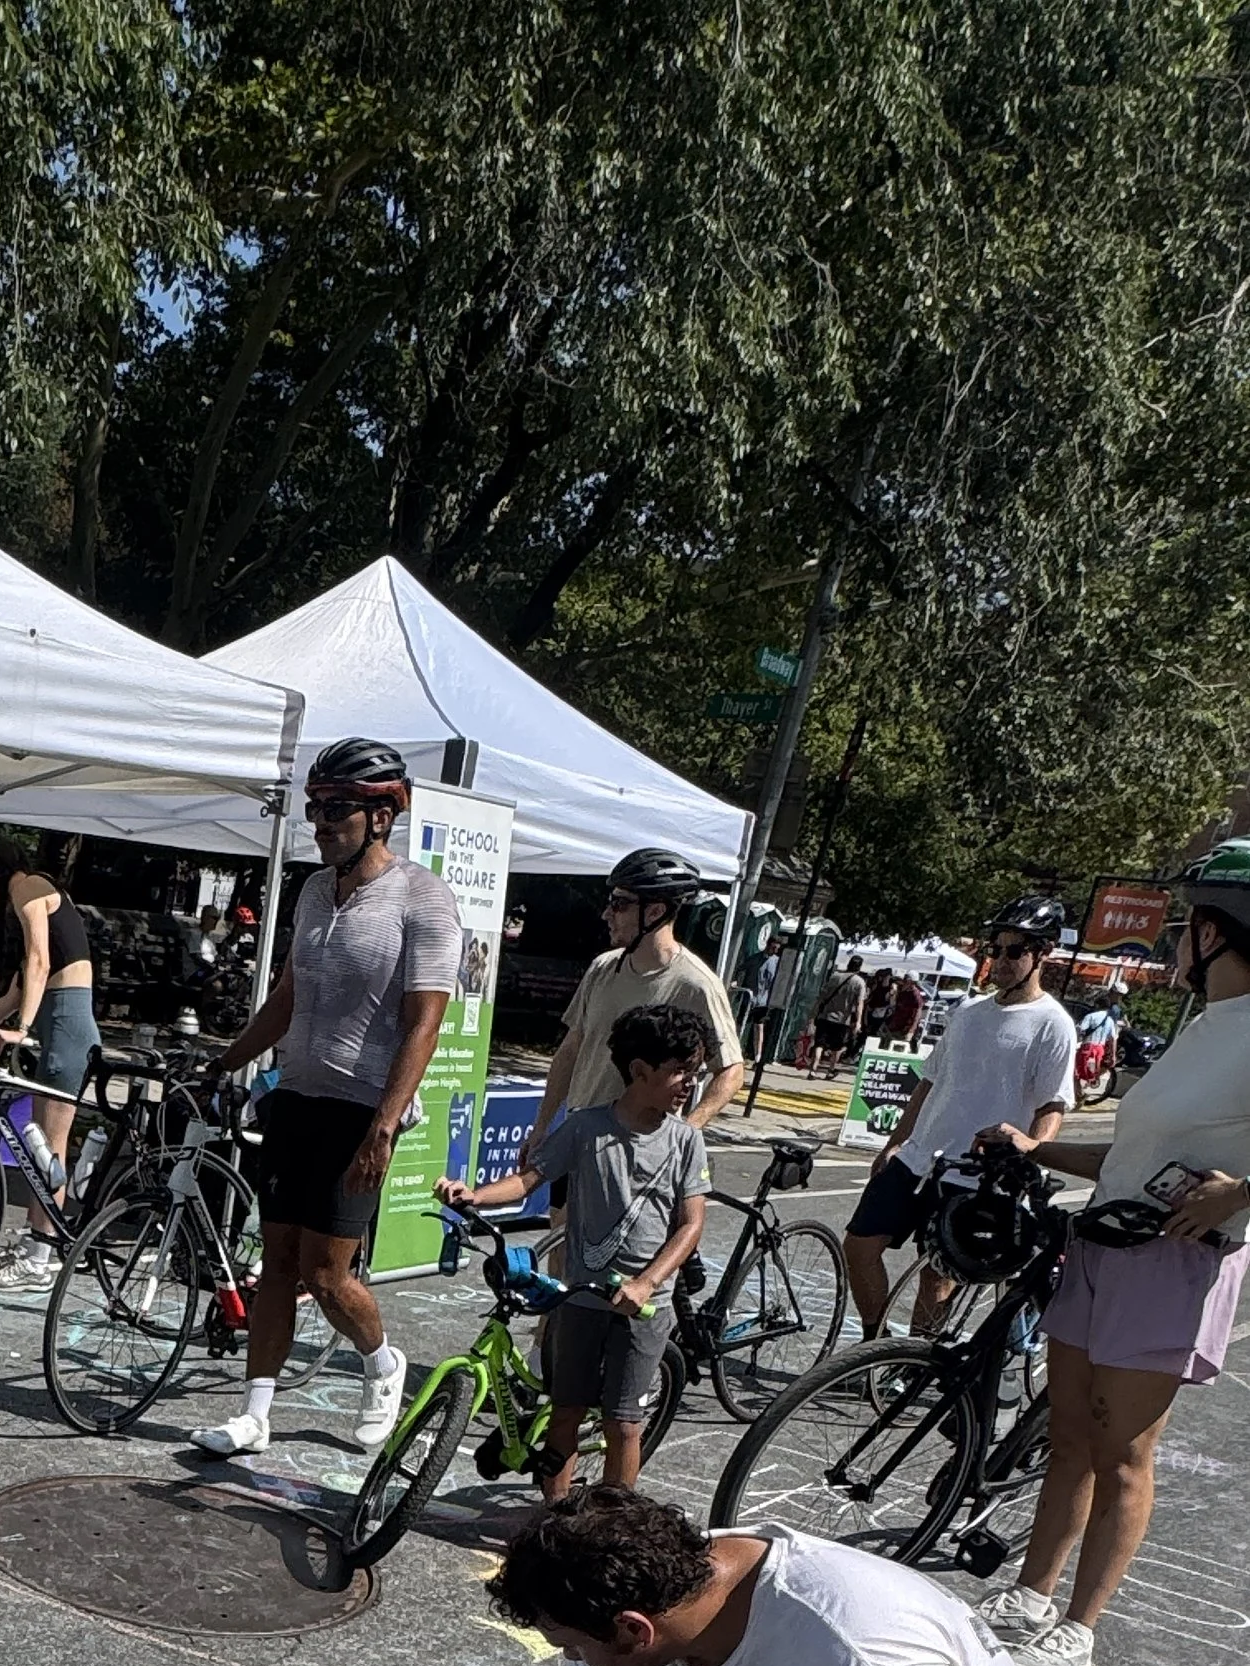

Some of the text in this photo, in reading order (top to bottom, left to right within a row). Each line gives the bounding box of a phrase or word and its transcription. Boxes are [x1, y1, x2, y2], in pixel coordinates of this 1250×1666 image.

[720, 697, 760, 720] Thayer
[451, 827, 499, 853] SCHOOL
[449, 850, 475, 865] IN THE
[447, 865, 496, 890] SQUARE
[1103, 894, 1164, 909] RESTROOMS
[864, 1058, 910, 1075] FREE
[861, 1071, 887, 1082] BIKE
[859, 1080, 902, 1092] HELMET
[857, 1088, 912, 1102] GIVEAWAY
[487, 1147, 520, 1162] IN TH
